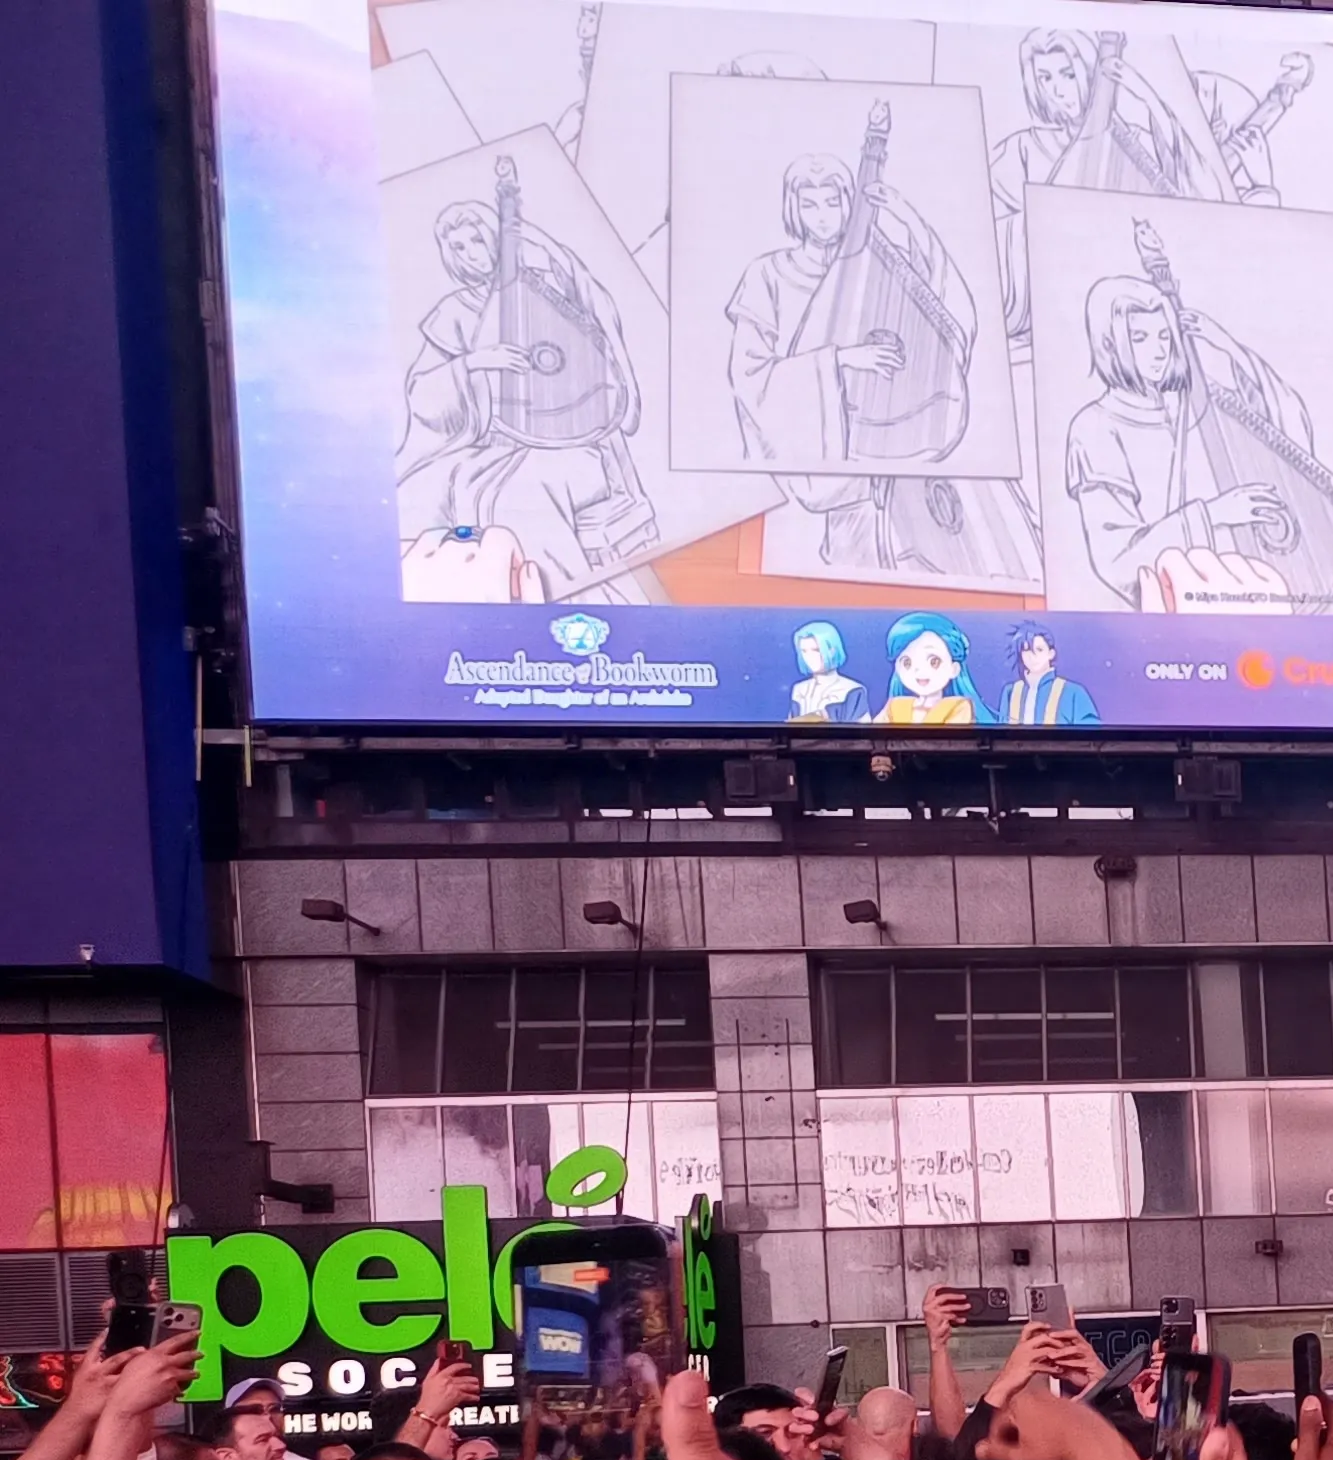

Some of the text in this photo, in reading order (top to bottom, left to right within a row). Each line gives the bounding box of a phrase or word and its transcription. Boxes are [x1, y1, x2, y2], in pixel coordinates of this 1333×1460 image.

[445, 651, 718, 687] Ascendance Bookworm
[1145, 663, 1194, 680] ONLY
[1198, 664, 1228, 680] ON
[284, 1413, 318, 1434] HE
